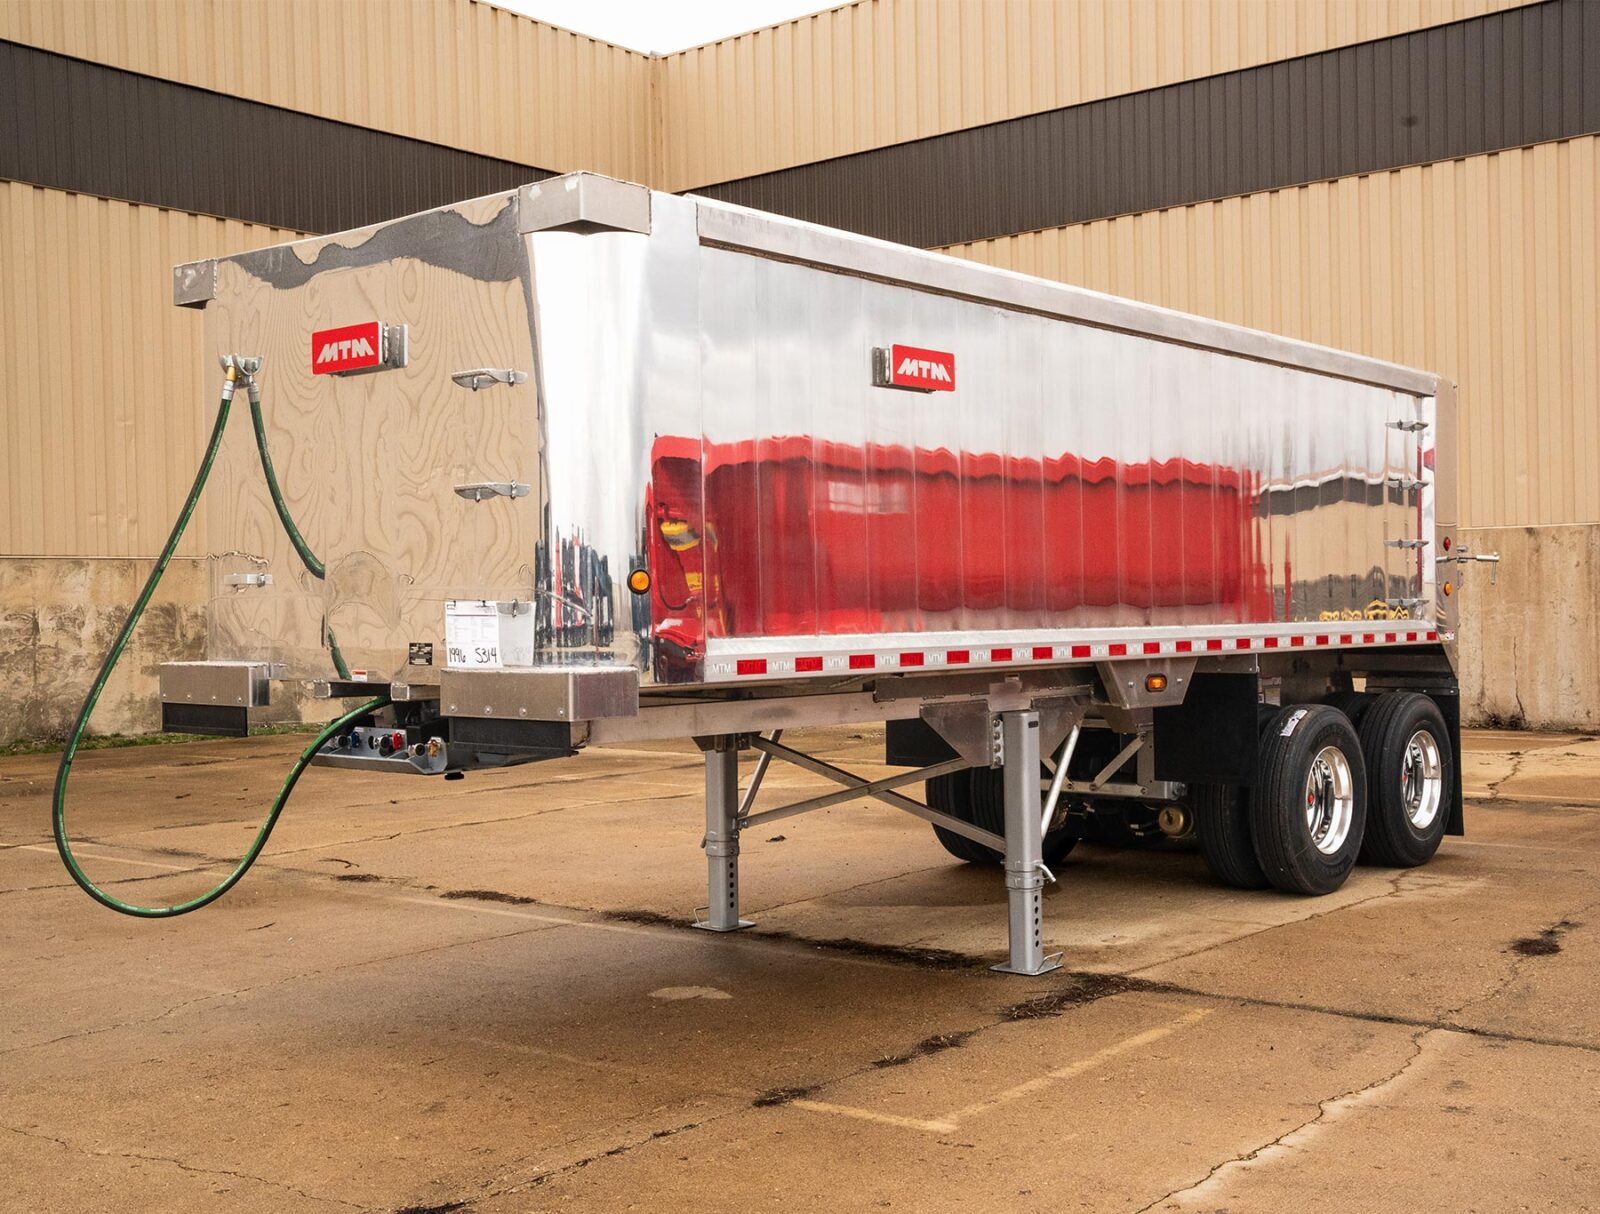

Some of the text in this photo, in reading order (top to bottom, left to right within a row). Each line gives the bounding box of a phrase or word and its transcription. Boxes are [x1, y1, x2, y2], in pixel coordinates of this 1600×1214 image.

[316, 337, 375, 365] MTM
[897, 357, 952, 383] MTM
[712, 663, 731, 674] MTM
[772, 661, 790, 671] MTM
[828, 656, 844, 668] MTM
